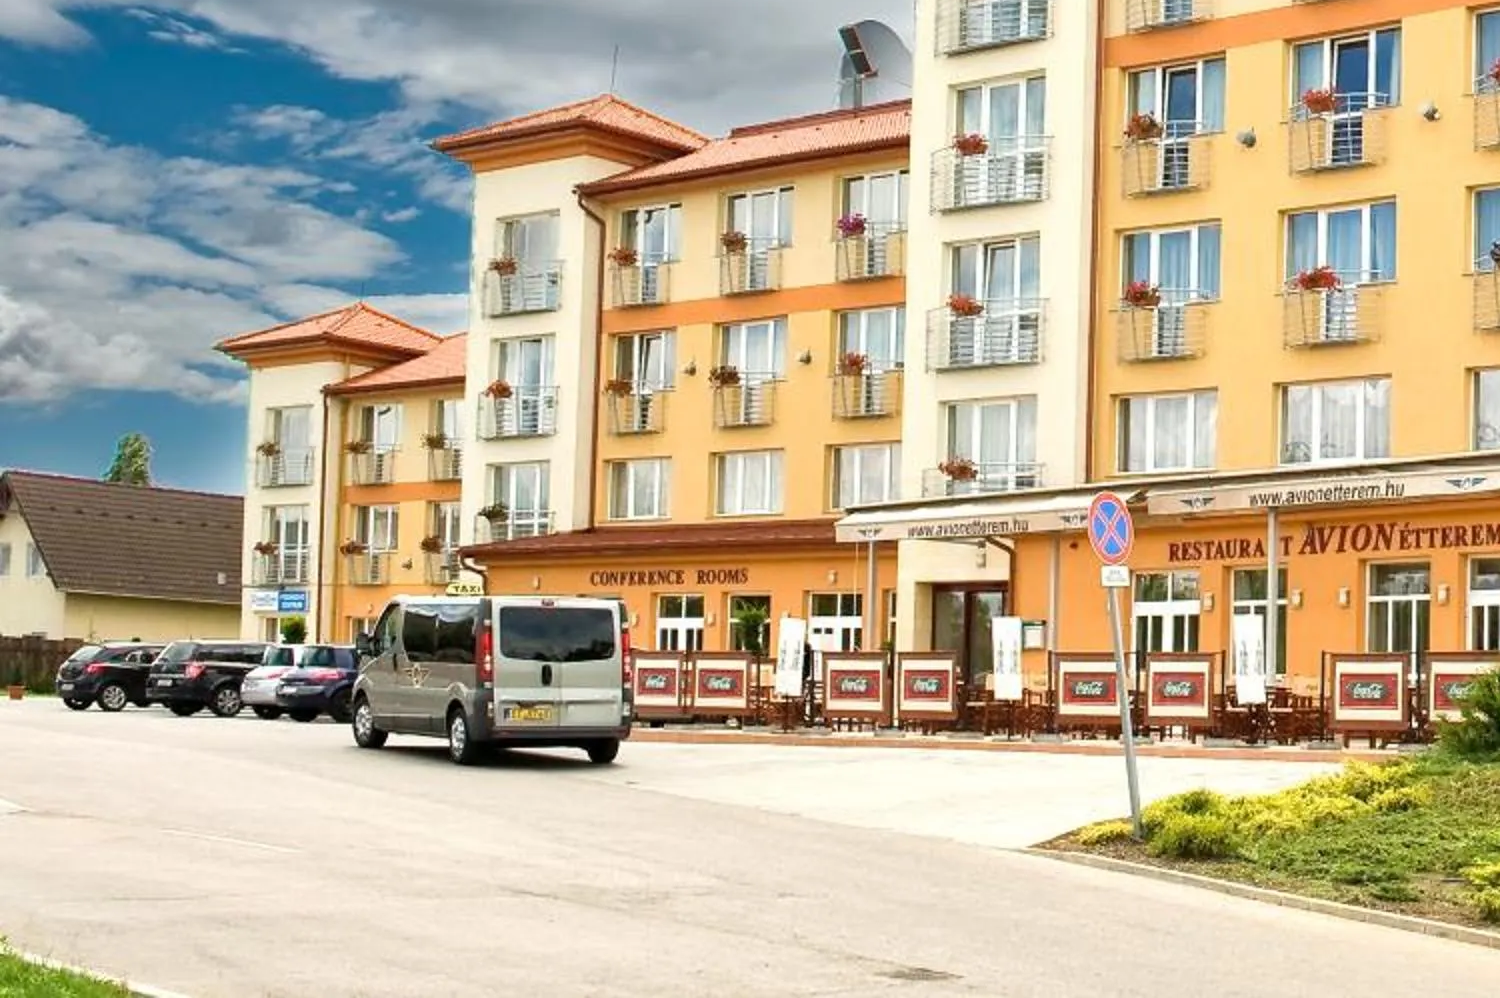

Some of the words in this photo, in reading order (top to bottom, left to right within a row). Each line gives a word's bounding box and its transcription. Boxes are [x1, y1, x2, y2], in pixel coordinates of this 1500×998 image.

[1168, 535, 1293, 562] RESTAURAT
[1298, 520, 1398, 555] AVION
[590, 569, 685, 587] CONFERENCE
[697, 567, 749, 585] ROOMS
[453, 585, 481, 593] TAXI
